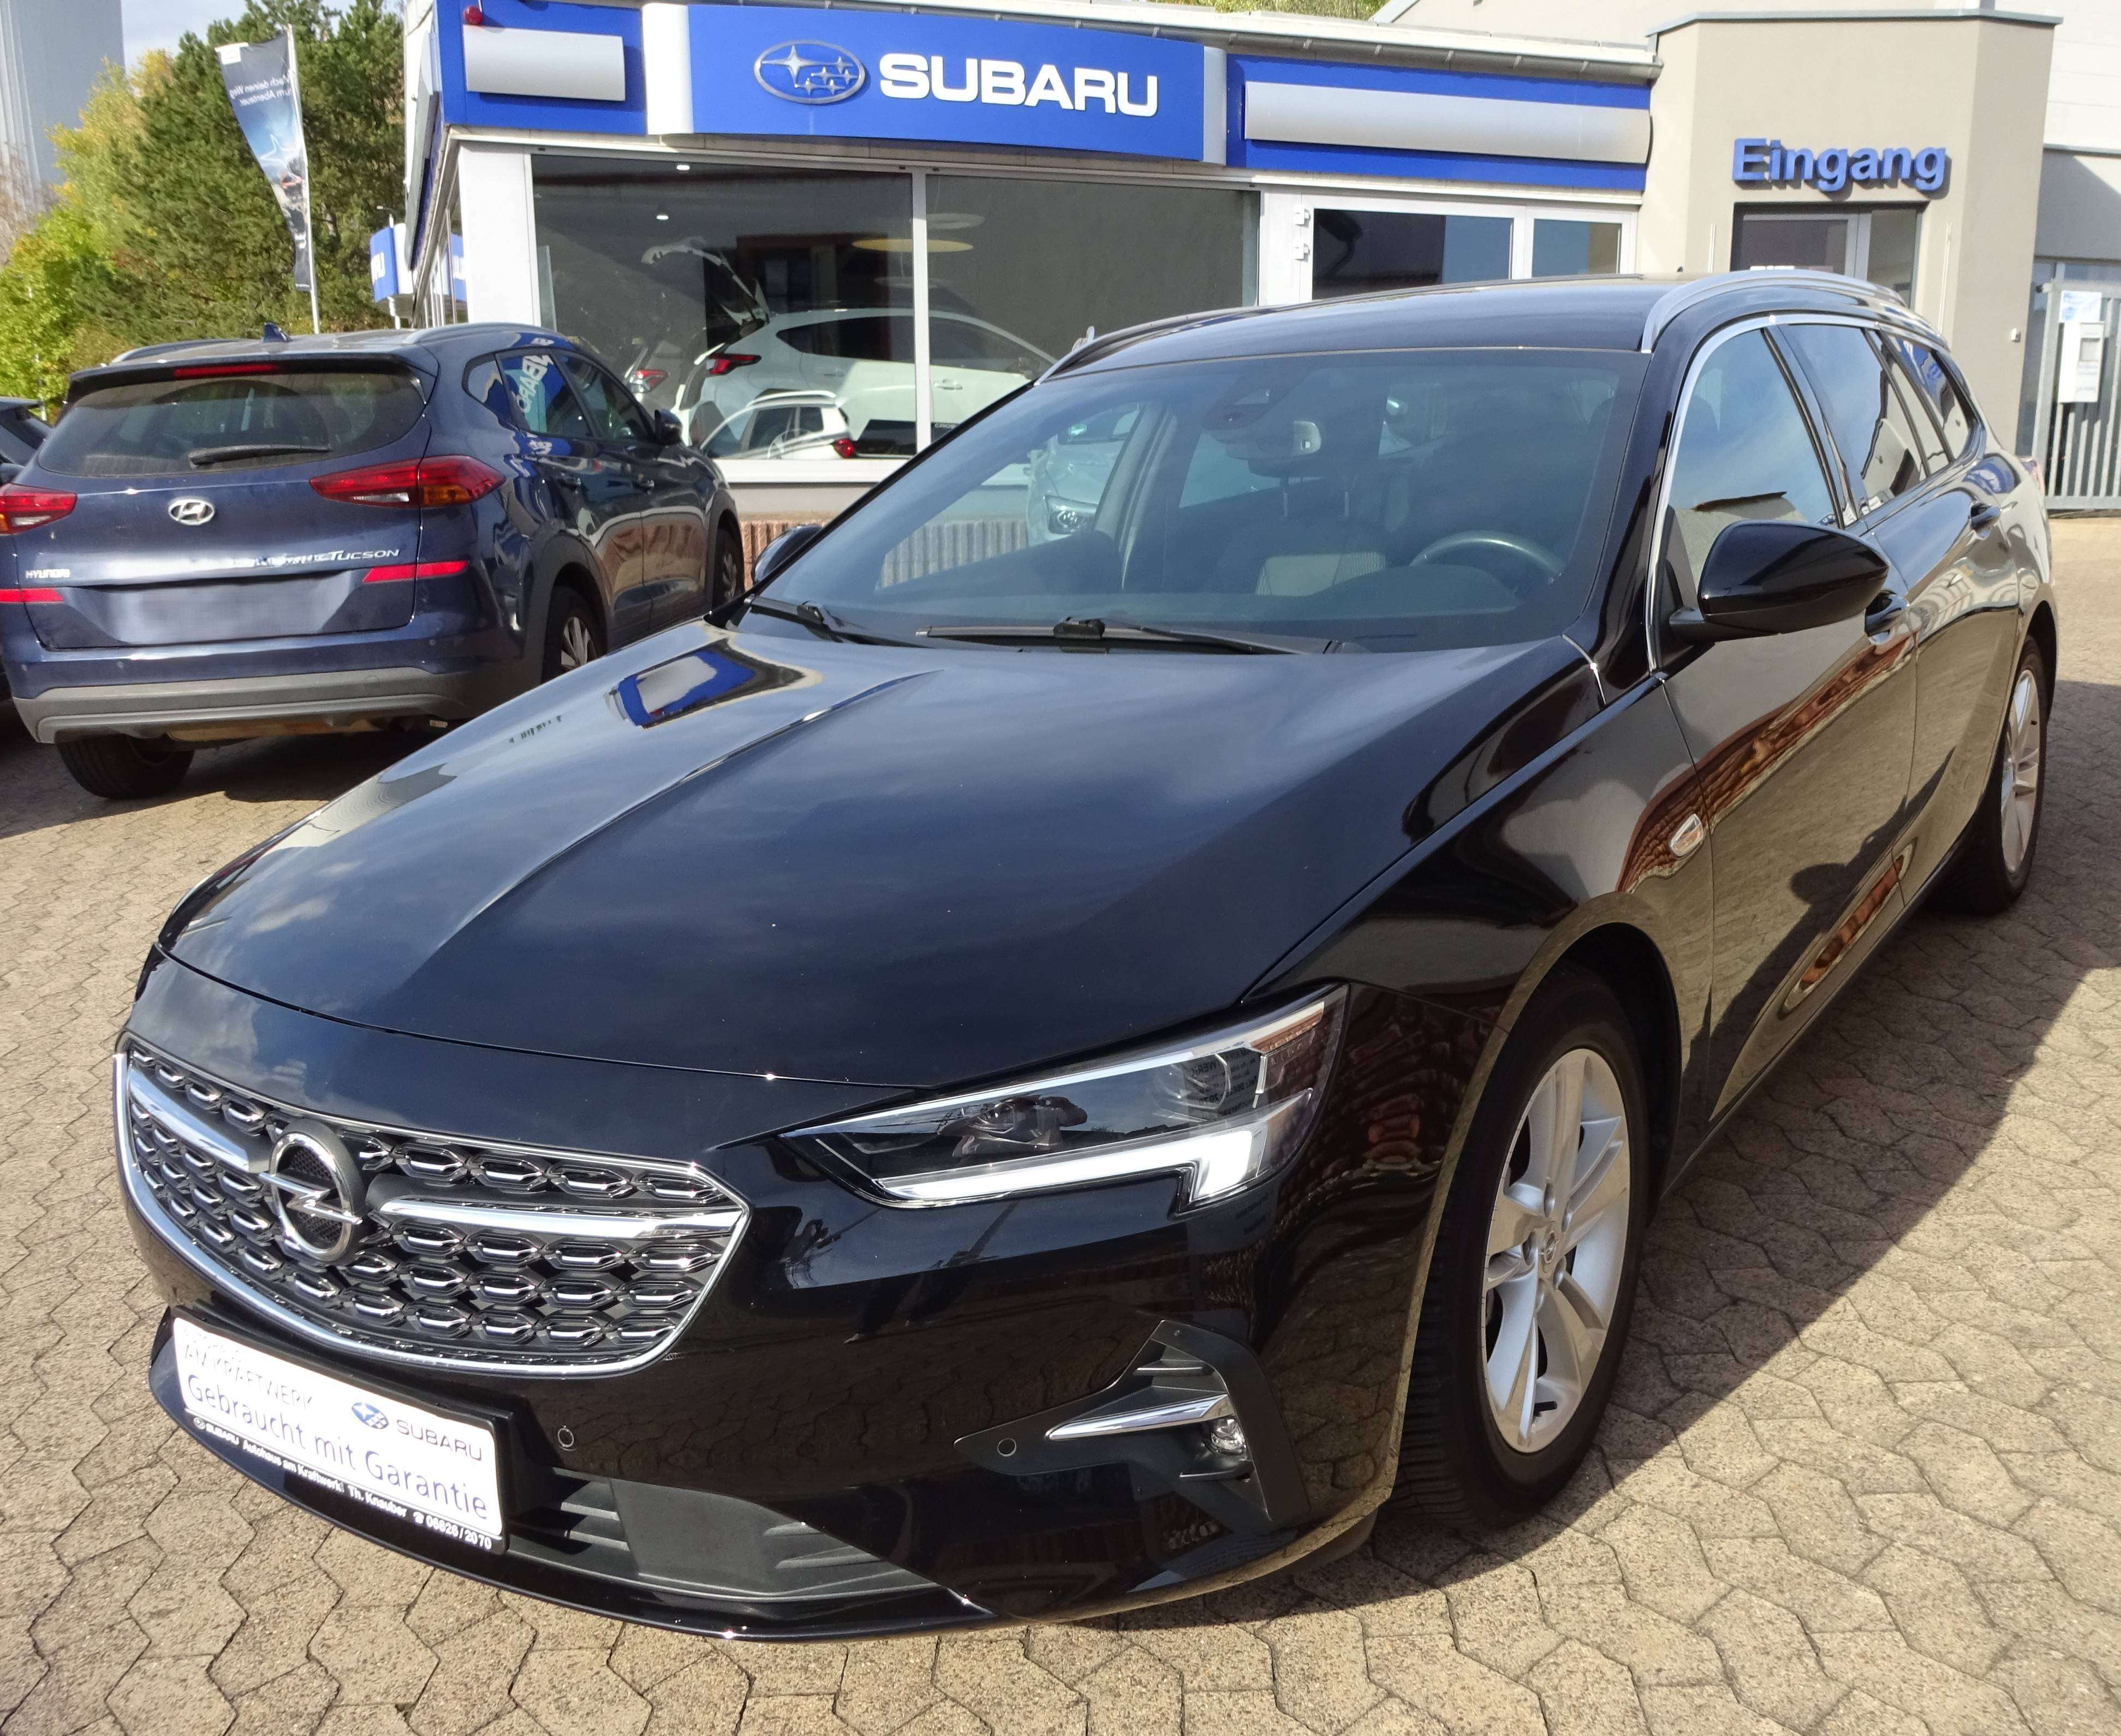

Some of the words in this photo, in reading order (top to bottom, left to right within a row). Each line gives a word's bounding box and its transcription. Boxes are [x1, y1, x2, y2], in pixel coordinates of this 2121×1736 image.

[879, 53, 1158, 117] SUBARU
[1732, 138, 1947, 192] Eingang
[329, 549, 400, 561] TUCSON
[188, 1374, 306, 1449] Gebraucht
[314, 1436, 356, 1471] mit
[365, 1450, 487, 1520] Garantie
[243, 1439, 282, 1466] Autohaus
[396, 1419, 482, 1461] SUBARU
